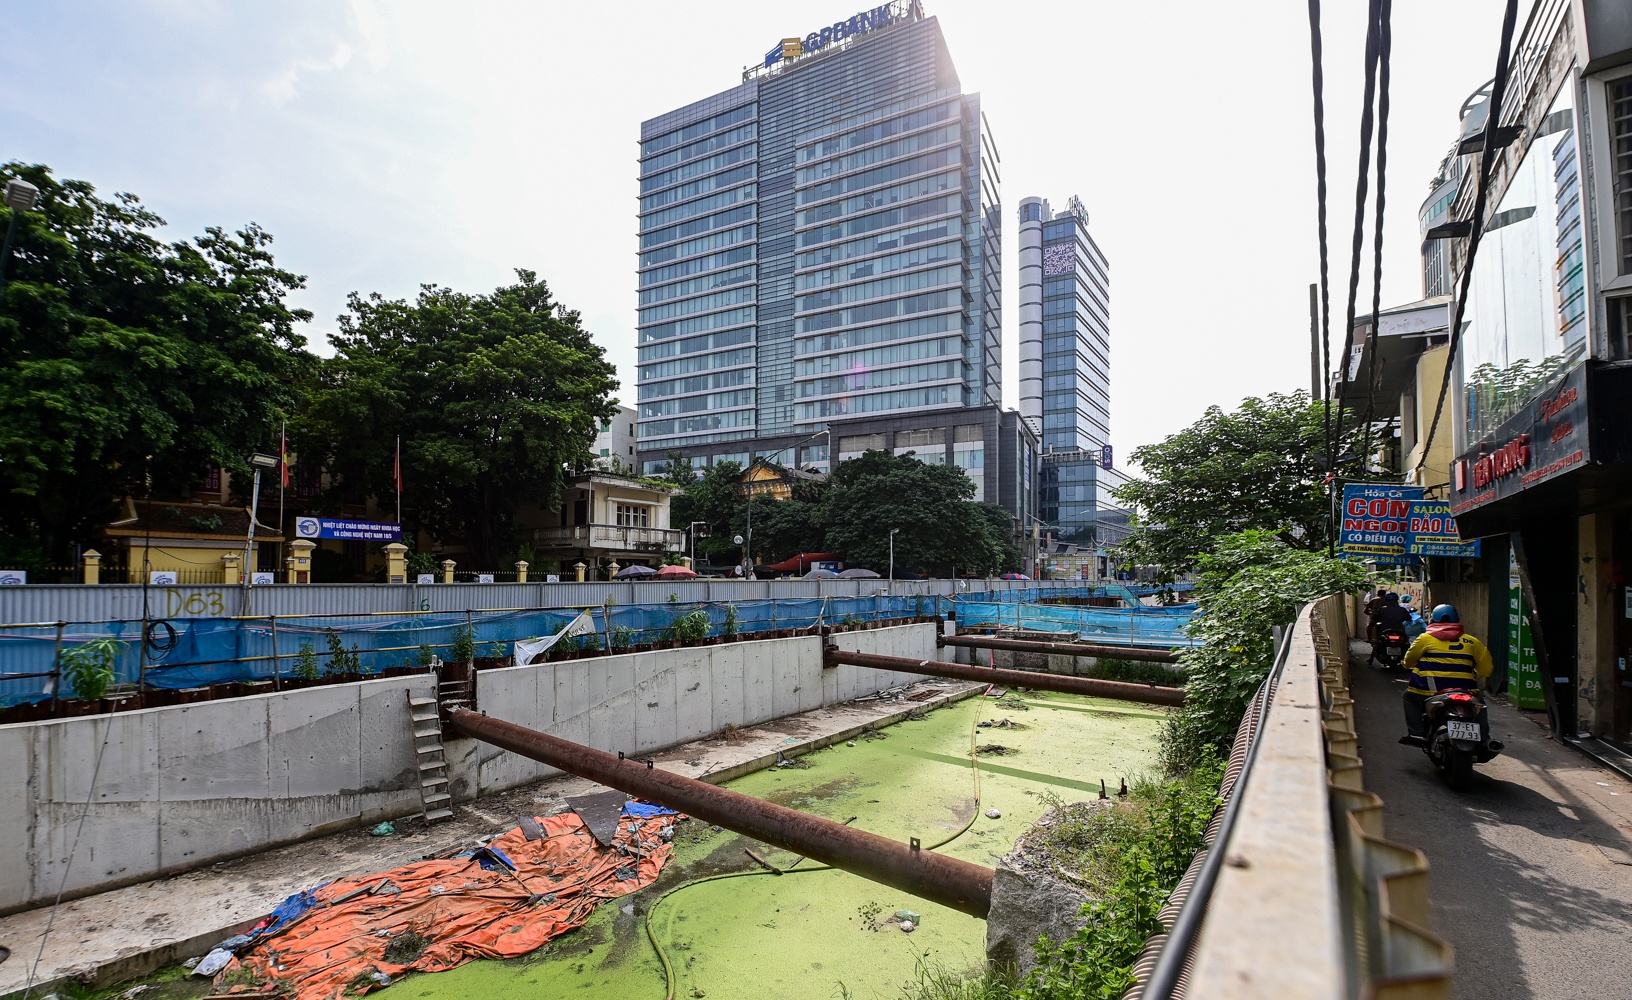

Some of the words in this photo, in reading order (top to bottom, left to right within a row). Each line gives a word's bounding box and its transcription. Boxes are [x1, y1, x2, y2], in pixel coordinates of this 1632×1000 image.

[805, 3, 891, 53] GPBANK
[1347, 497, 1410, 518] CƠM
[1413, 505, 1451, 515] SALON
[336, 522, 345, 530] LIỆT
[345, 522, 357, 530] CHÀO
[1411, 513, 1442, 533] BẢO
[364, 531, 373, 539] VIỆT
[1348, 533, 1363, 542] CÓ
[1389, 534, 1407, 544] HÒ
[1410, 544, 1424, 554] ĐT
[167, 588, 225, 618] D63
[1452, 722, 1474, 732] 37-E1
[1450, 730, 1479, 740] 777.93
